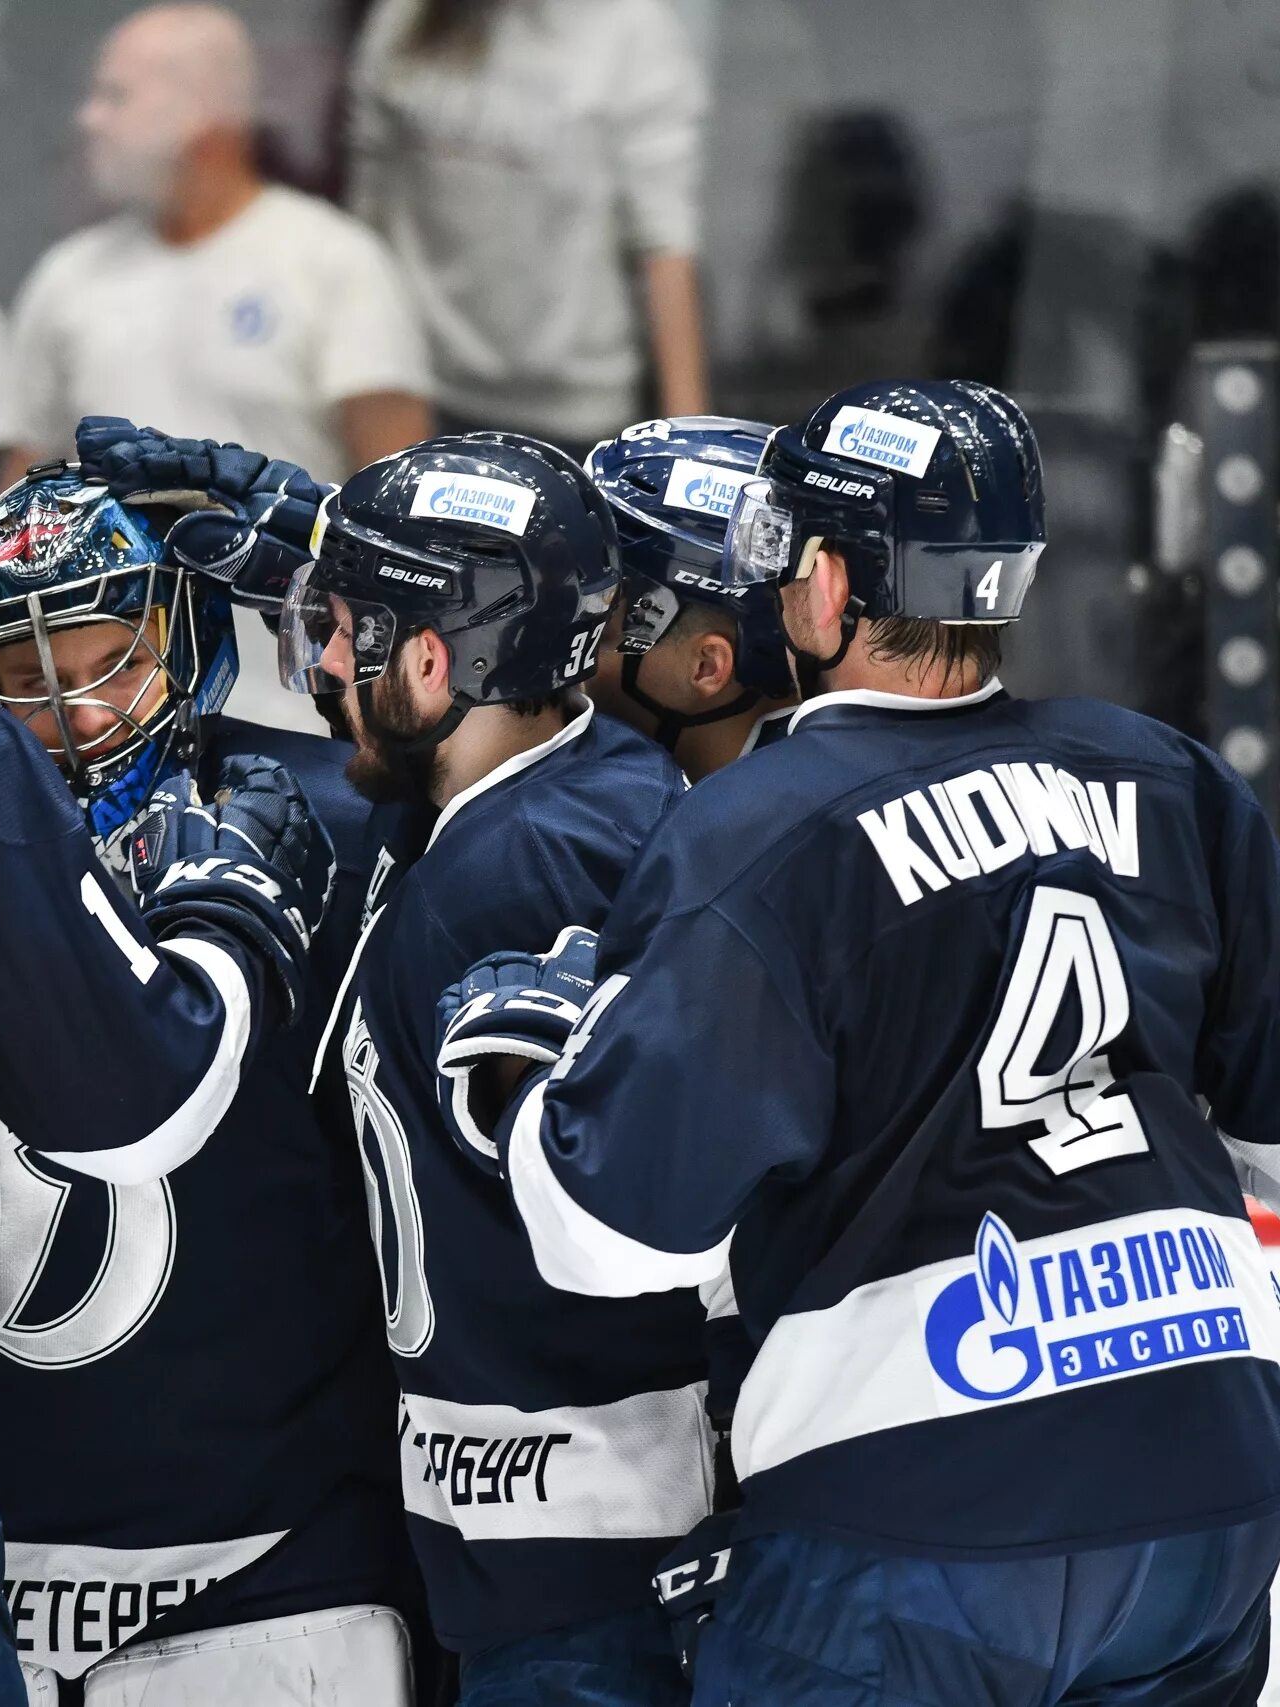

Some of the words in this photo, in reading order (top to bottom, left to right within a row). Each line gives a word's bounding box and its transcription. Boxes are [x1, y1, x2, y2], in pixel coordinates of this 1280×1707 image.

[857, 445, 910, 468] ЭКСПОРТ
[861, 426, 918, 454] ГАЗПРОМ
[452, 506, 510, 526] ЭКСПОРТ
[455, 488, 517, 513] ГАЗПРОМ
[674, 570, 750, 598] CCM
[976, 560, 1003, 611] 4
[563, 621, 607, 678] 32
[856, 762, 1140, 906] KUDINOV
[977, 886, 1150, 1176] 4
[1030, 1226, 1235, 1323] ГАЗПРОМ
[1060, 1314, 1245, 1377] ЭКСПОРТ
